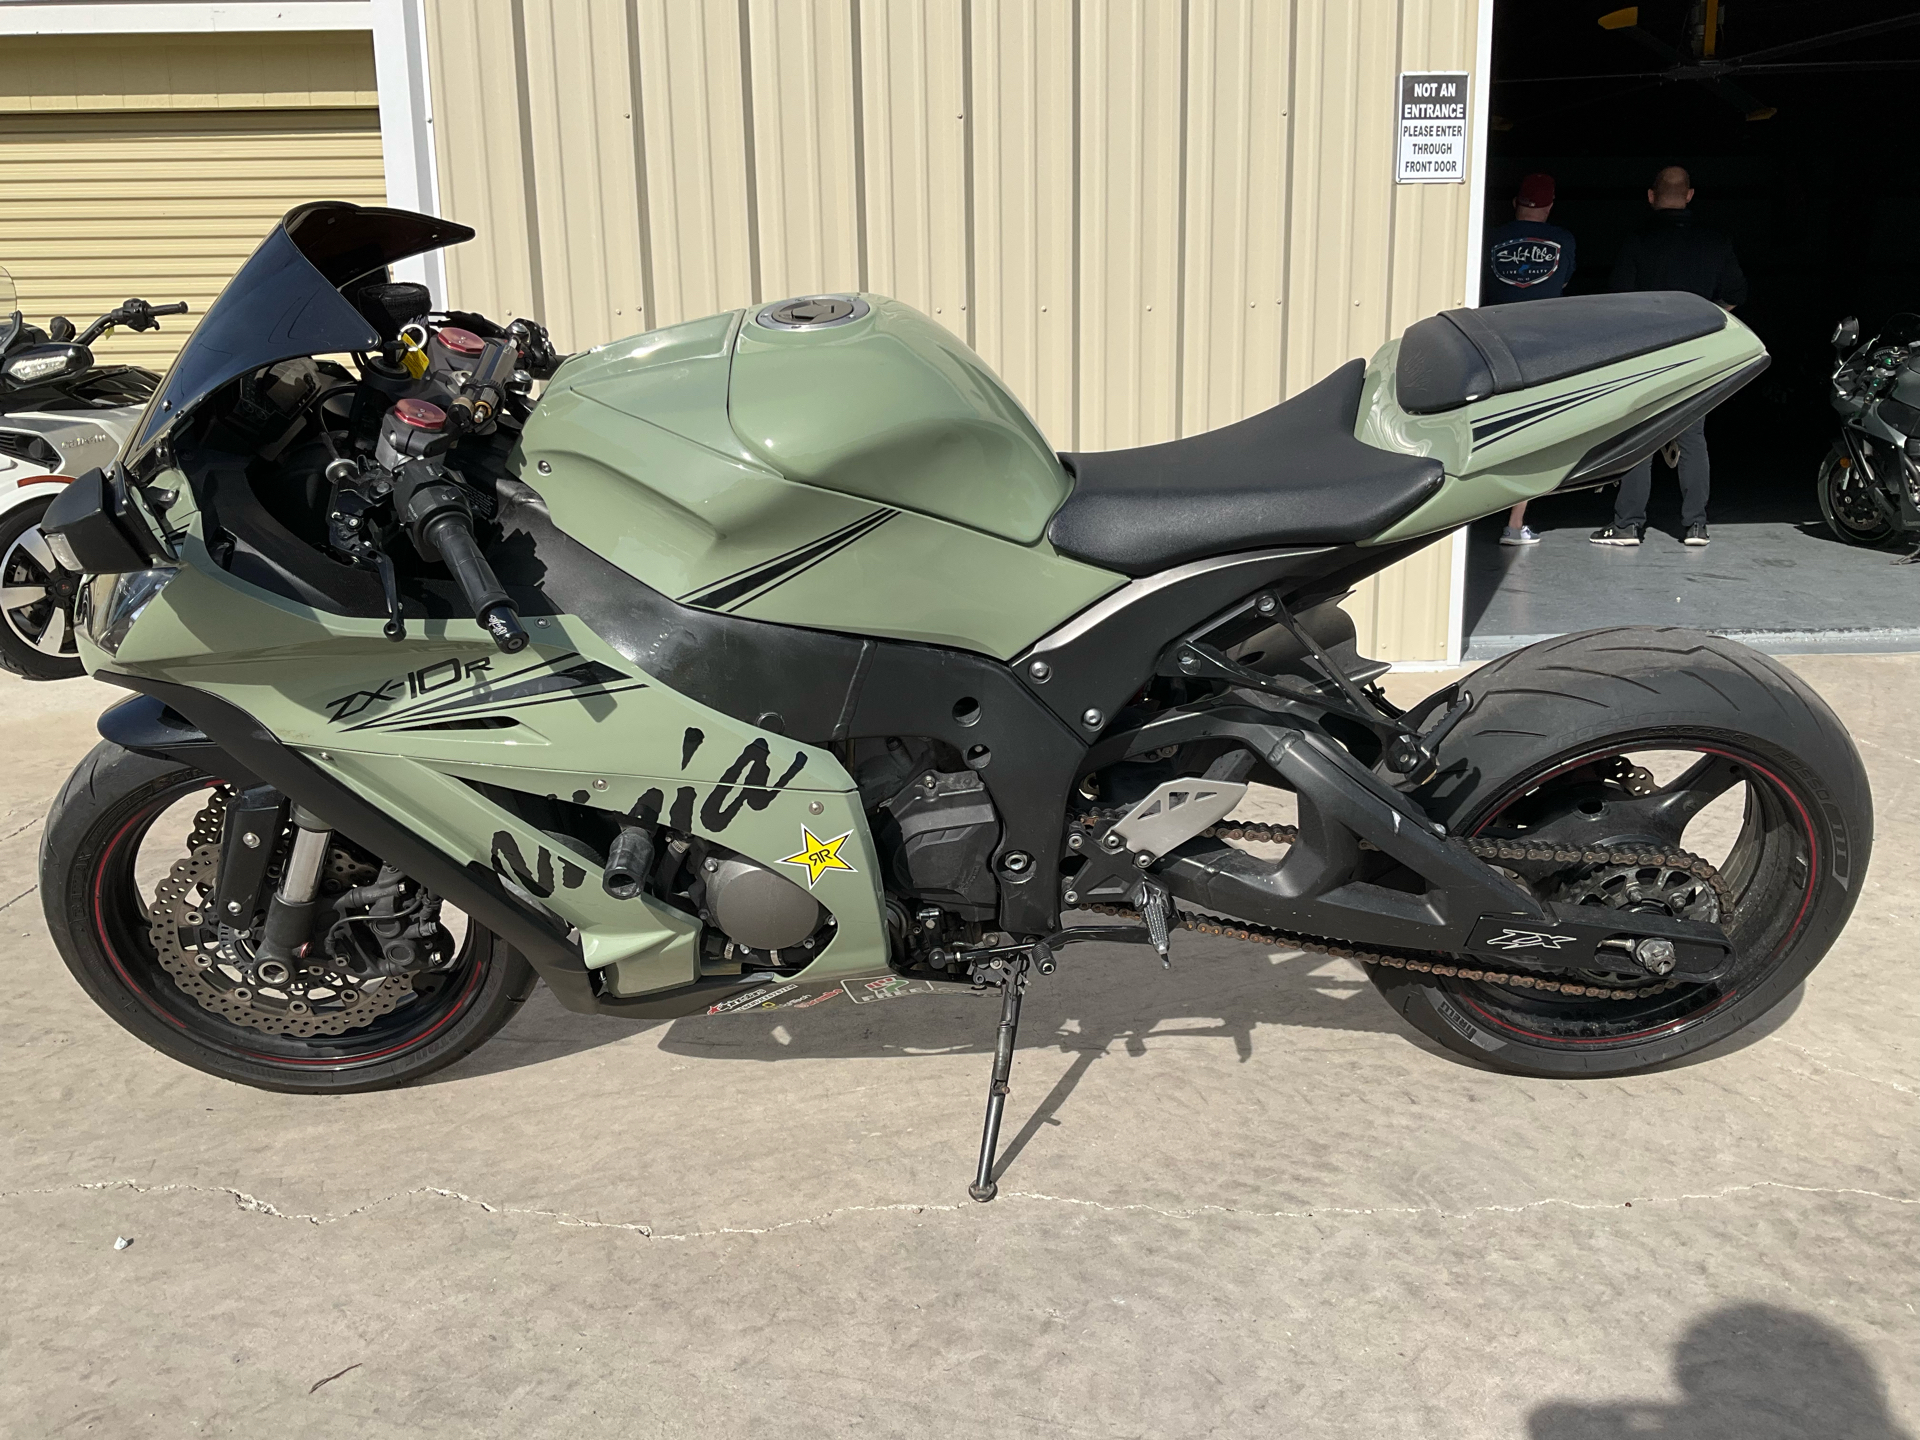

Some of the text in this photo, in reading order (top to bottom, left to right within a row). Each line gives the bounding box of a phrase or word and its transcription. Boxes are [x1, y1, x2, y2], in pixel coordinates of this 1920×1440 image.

[1414, 83, 1456, 97] NOT AN
[1404, 104, 1464, 118] ENTRANCE
[1403, 125, 1463, 137] PLEASE ENTER
[1412, 143, 1452, 155] THROUGH
[1405, 161, 1457, 172] FRONT DOOR
[1437, 1001, 1478, 1040] PIRELLI
